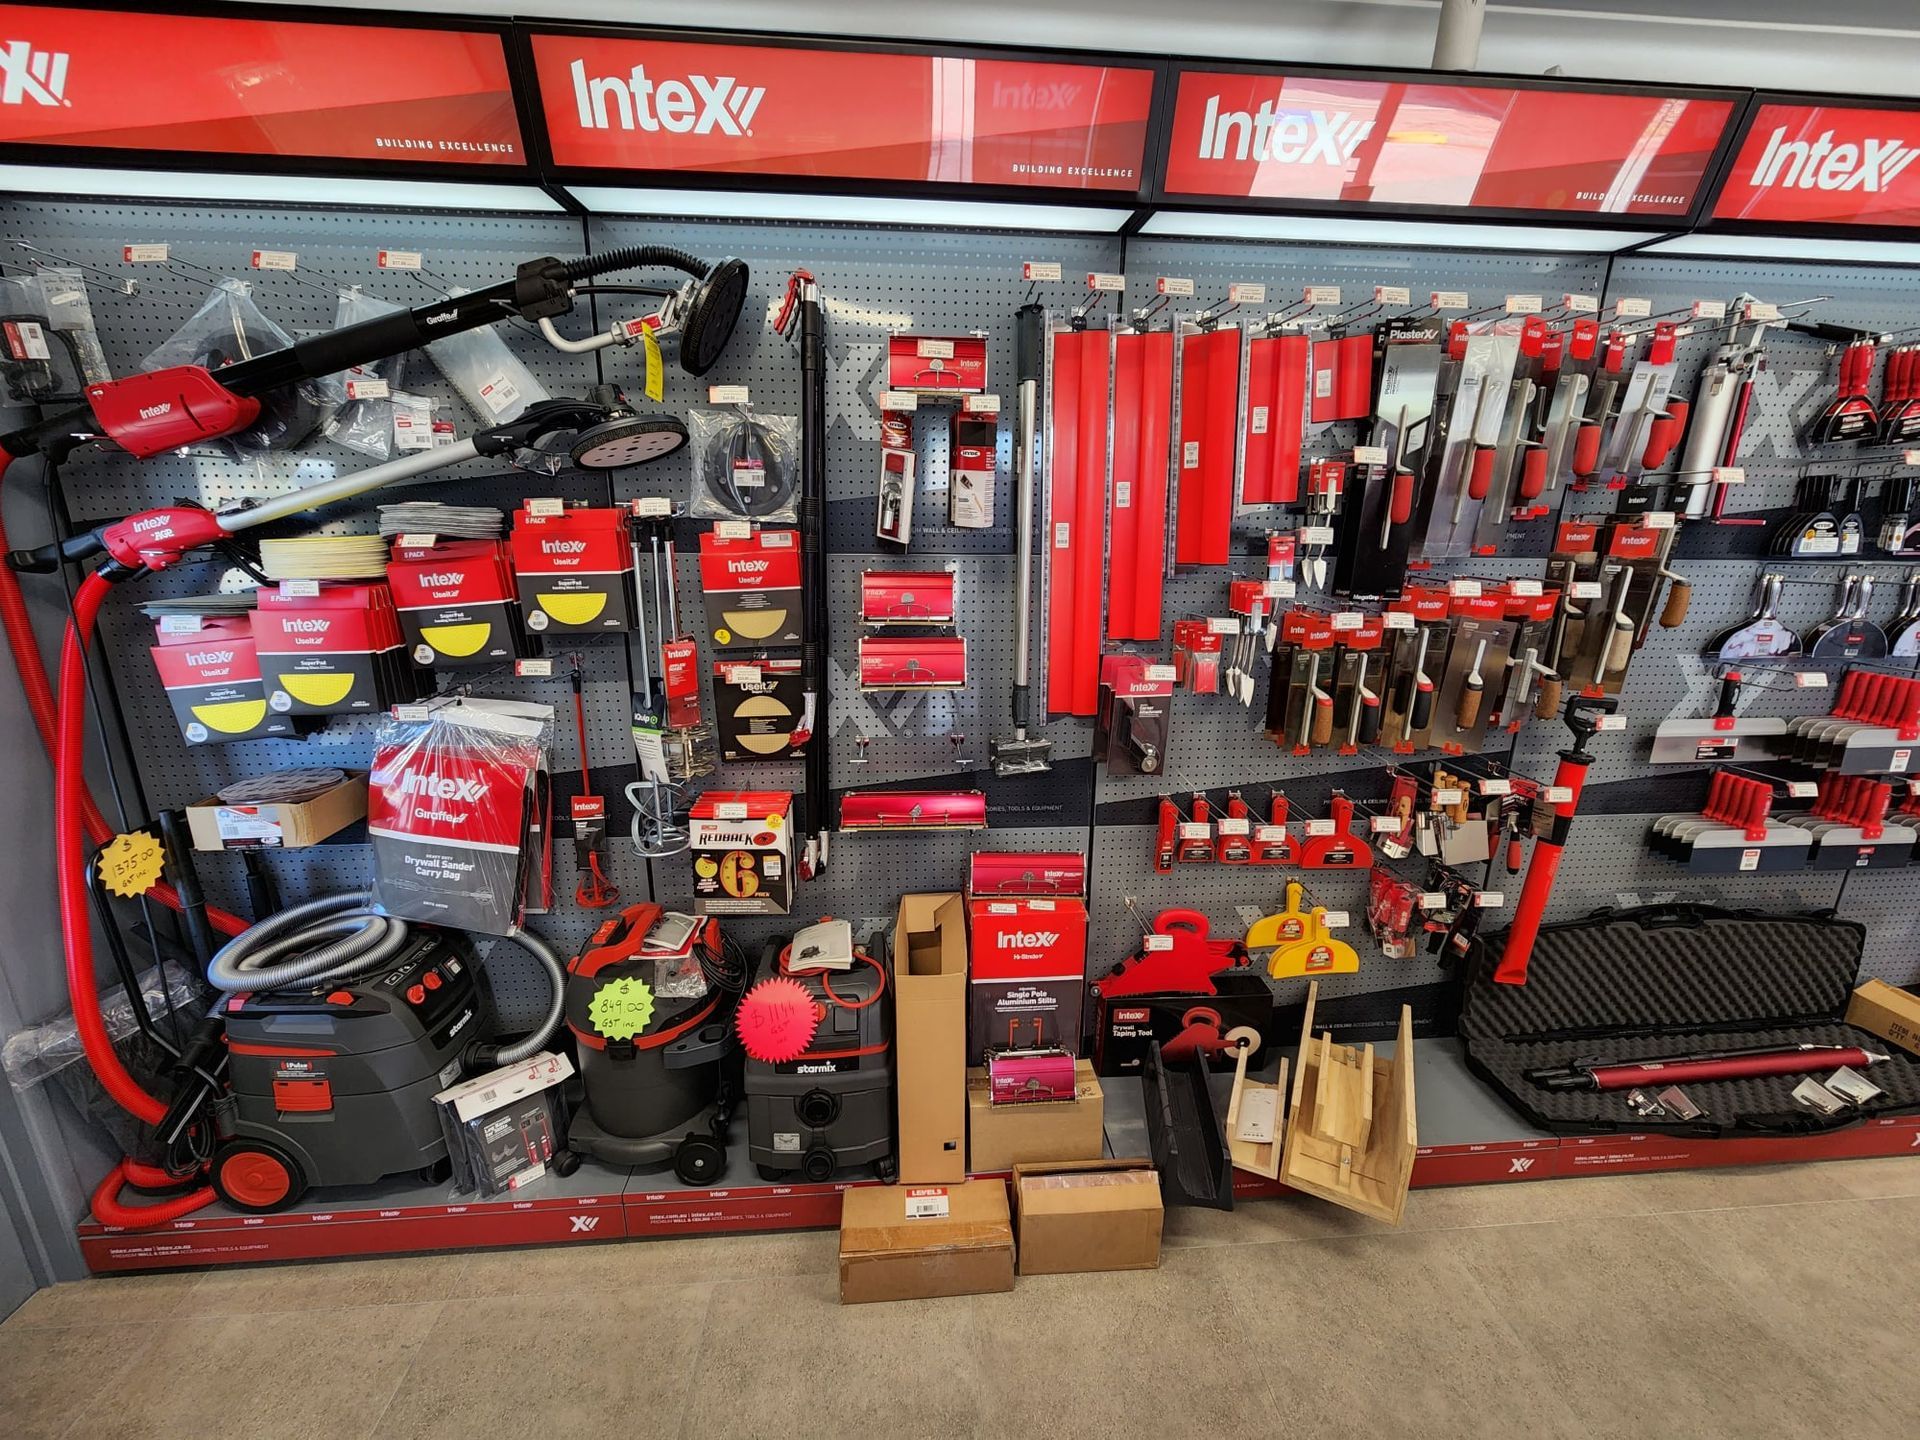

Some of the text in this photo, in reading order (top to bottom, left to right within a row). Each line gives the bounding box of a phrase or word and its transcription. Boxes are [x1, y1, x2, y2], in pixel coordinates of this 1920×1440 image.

[376, 137, 514, 153] BUILDING EXCELLENCE
[1012, 163, 1134, 178] BUILDING EXCELLENCE
[1576, 190, 1686, 204] BUILD XCELLENCE
[426, 308, 458, 325] Giraffe
[1454, 332, 1469, 342] Inte
[1290, 626, 1305, 634] Inte
[400, 767, 489, 803] Intex
[414, 808, 468, 824] Giraffe
[404, 856, 476, 872] Drywall Sander
[416, 866, 461, 882] Carry Bag
[997, 930, 1060, 948] Intex
[996, 997, 1056, 1007] Aluminium Stilts
[1007, 990, 1047, 1000] Single Pole
[600, 998, 645, 1014] 849.00
[1112, 1030, 1136, 1038] Taping
[796, 1060, 836, 1074] starmix
[912, 1188, 942, 1196] LEVELS
